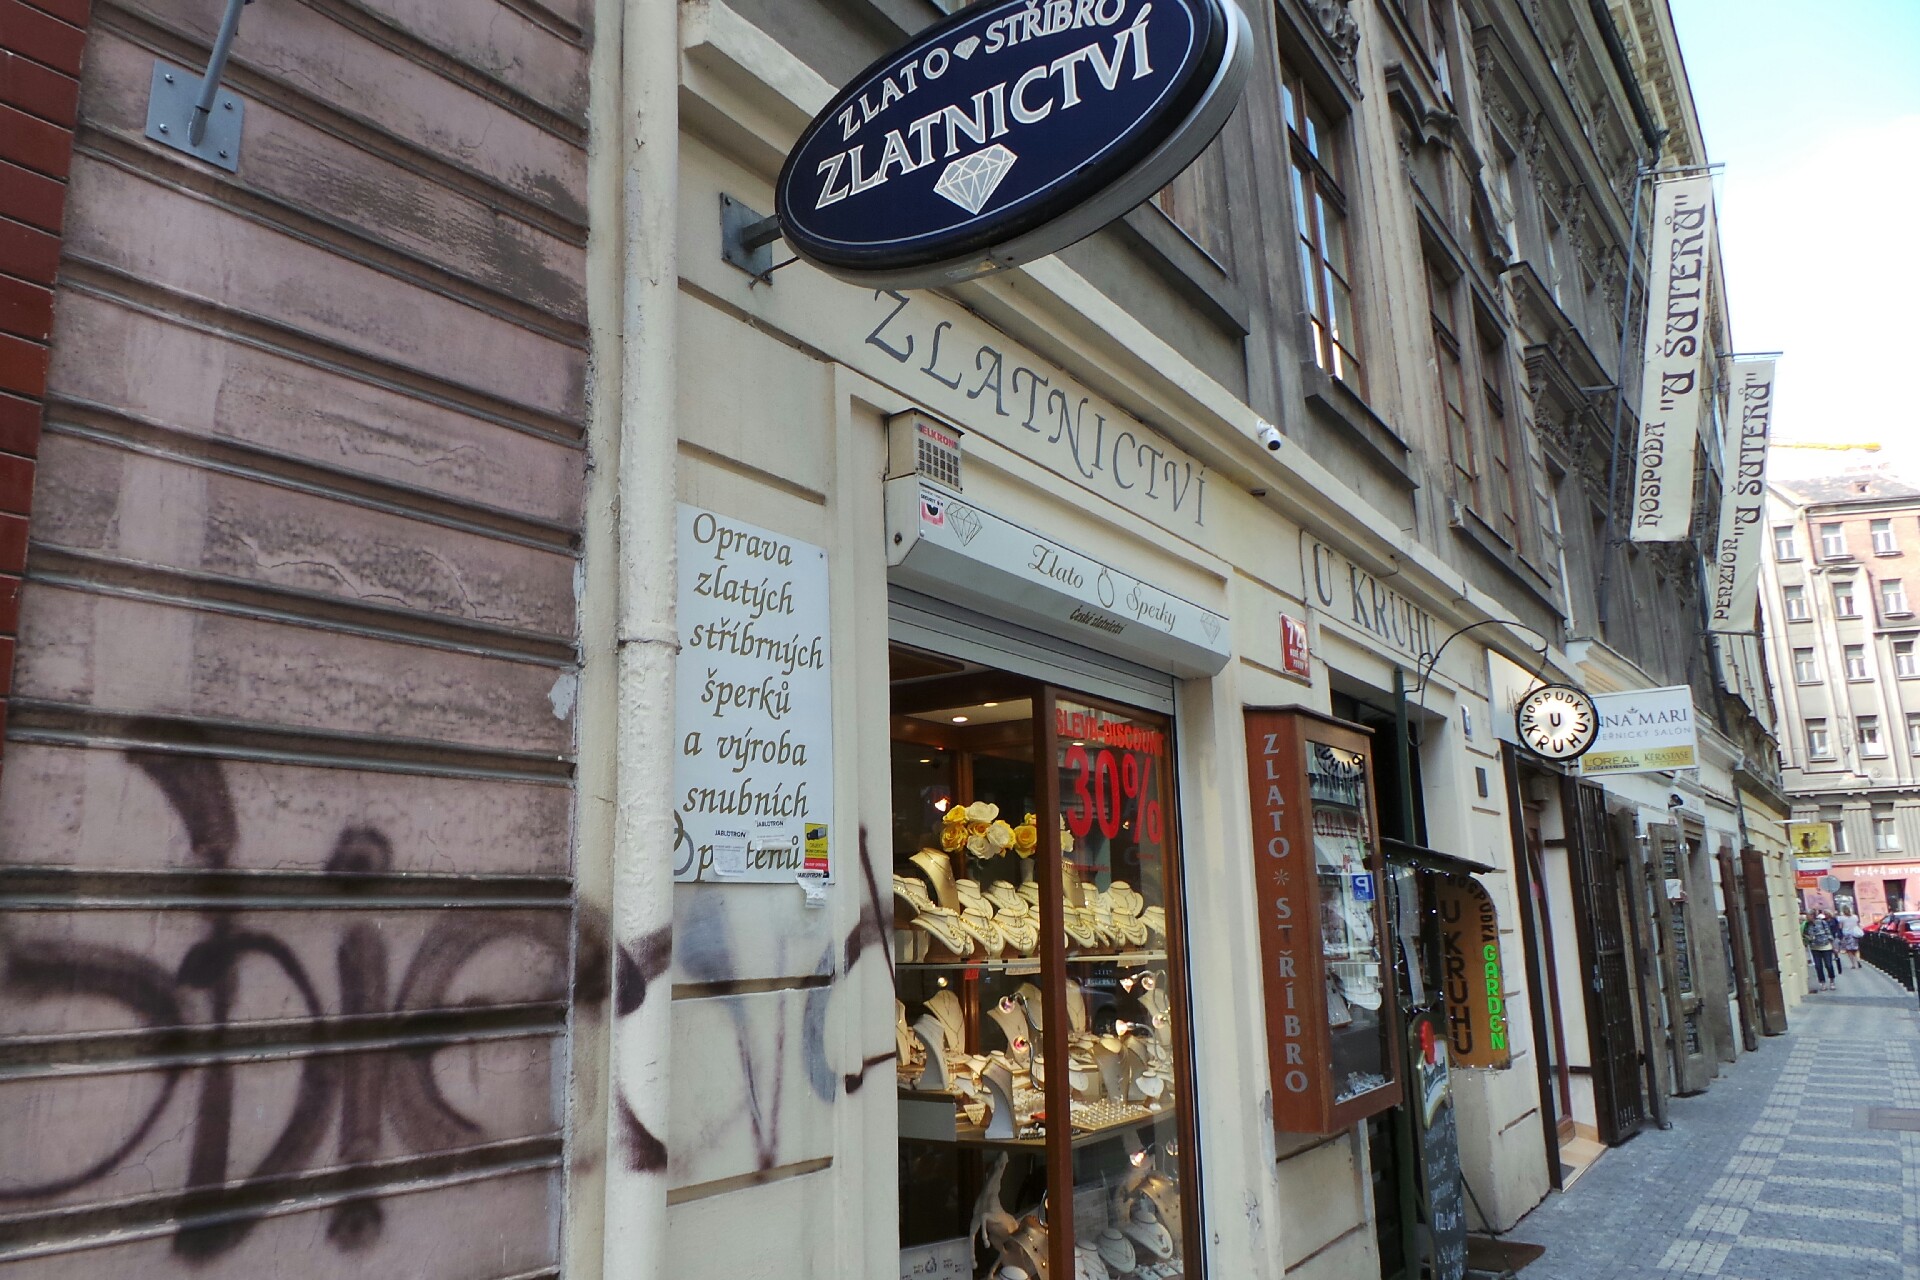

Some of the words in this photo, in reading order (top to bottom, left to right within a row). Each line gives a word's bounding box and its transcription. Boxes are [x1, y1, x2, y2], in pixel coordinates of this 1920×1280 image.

[838, 47, 949, 142] ZLATO
[984, 0, 1126, 56] STŘÍBRO
[815, 3, 1154, 210] ZLATNICTVÍ
[865, 288, 1206, 527] ZLATNICTVÍ
[1637, 421, 1665, 528] HOSPODA
[693, 513, 793, 566] Oprava
[693, 564, 794, 619] zlatých
[1027, 544, 1084, 590] Zlato
[1126, 582, 1177, 633] Šperky
[1313, 542, 1334, 607] U
[1346, 560, 1438, 666] KRUHU
[690, 617, 824, 675] stříbrných
[701, 667, 792, 720] šperků
[1550, 712, 1561, 727] U
[1639, 708, 1688, 726] MARI
[683, 731, 702, 756] a
[717, 727, 808, 773] výroba
[1523, 721, 1589, 753] KRUHU
[683, 777, 809, 818] snubních
[1065, 745, 1163, 845] 30%
[1263, 733, 1291, 859] ZLATO
[715, 829, 747, 838] JABLOTRON
[757, 820, 784, 828] JABLOTRON
[694, 835, 801, 882] ptenů
[1440, 900, 1461, 924] U
[1275, 896, 1309, 1094] STŘÍBRO
[1444, 930, 1474, 1056] KRUHU
[1482, 944, 1506, 1050] GARDEN
